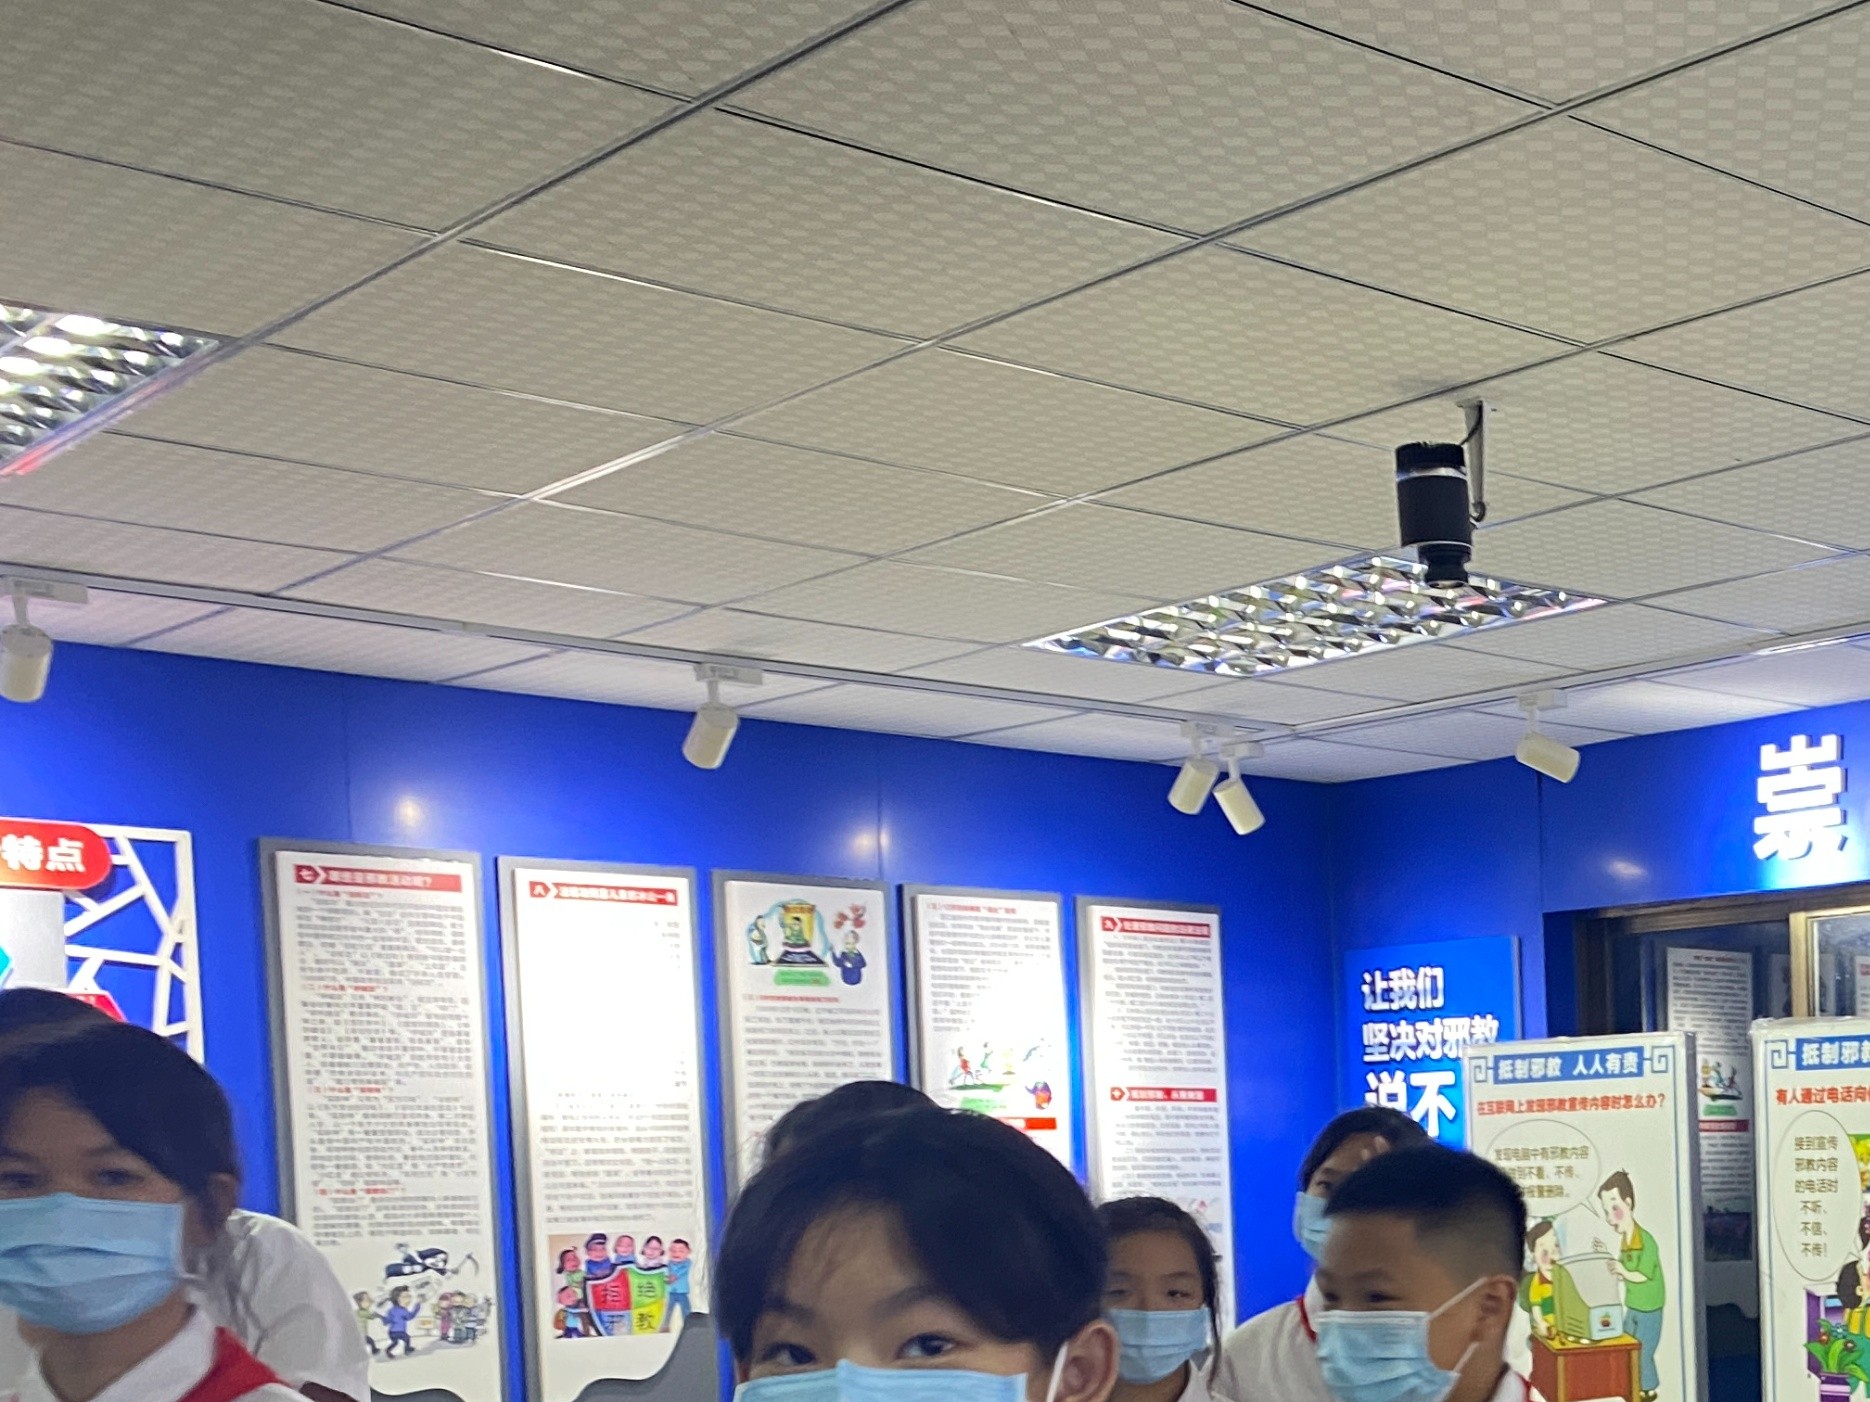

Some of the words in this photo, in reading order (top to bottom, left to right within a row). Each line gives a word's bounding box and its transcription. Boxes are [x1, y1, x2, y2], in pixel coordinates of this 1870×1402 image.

[1, 834, 85, 872] 特点
[1361, 966, 1444, 1011] 让我们
[1362, 1014, 1499, 1062] 坚决对邪教
[1498, 1056, 1562, 1080] 抵制邪教
[1573, 1052, 1639, 1075] 人人有责
[1365, 1070, 1456, 1138] 说不
[1794, 1136, 1838, 1151] 接到宣传
[1794, 1157, 1838, 1172] 邪教内容
[1794, 1178, 1838, 1194] 的电话时
